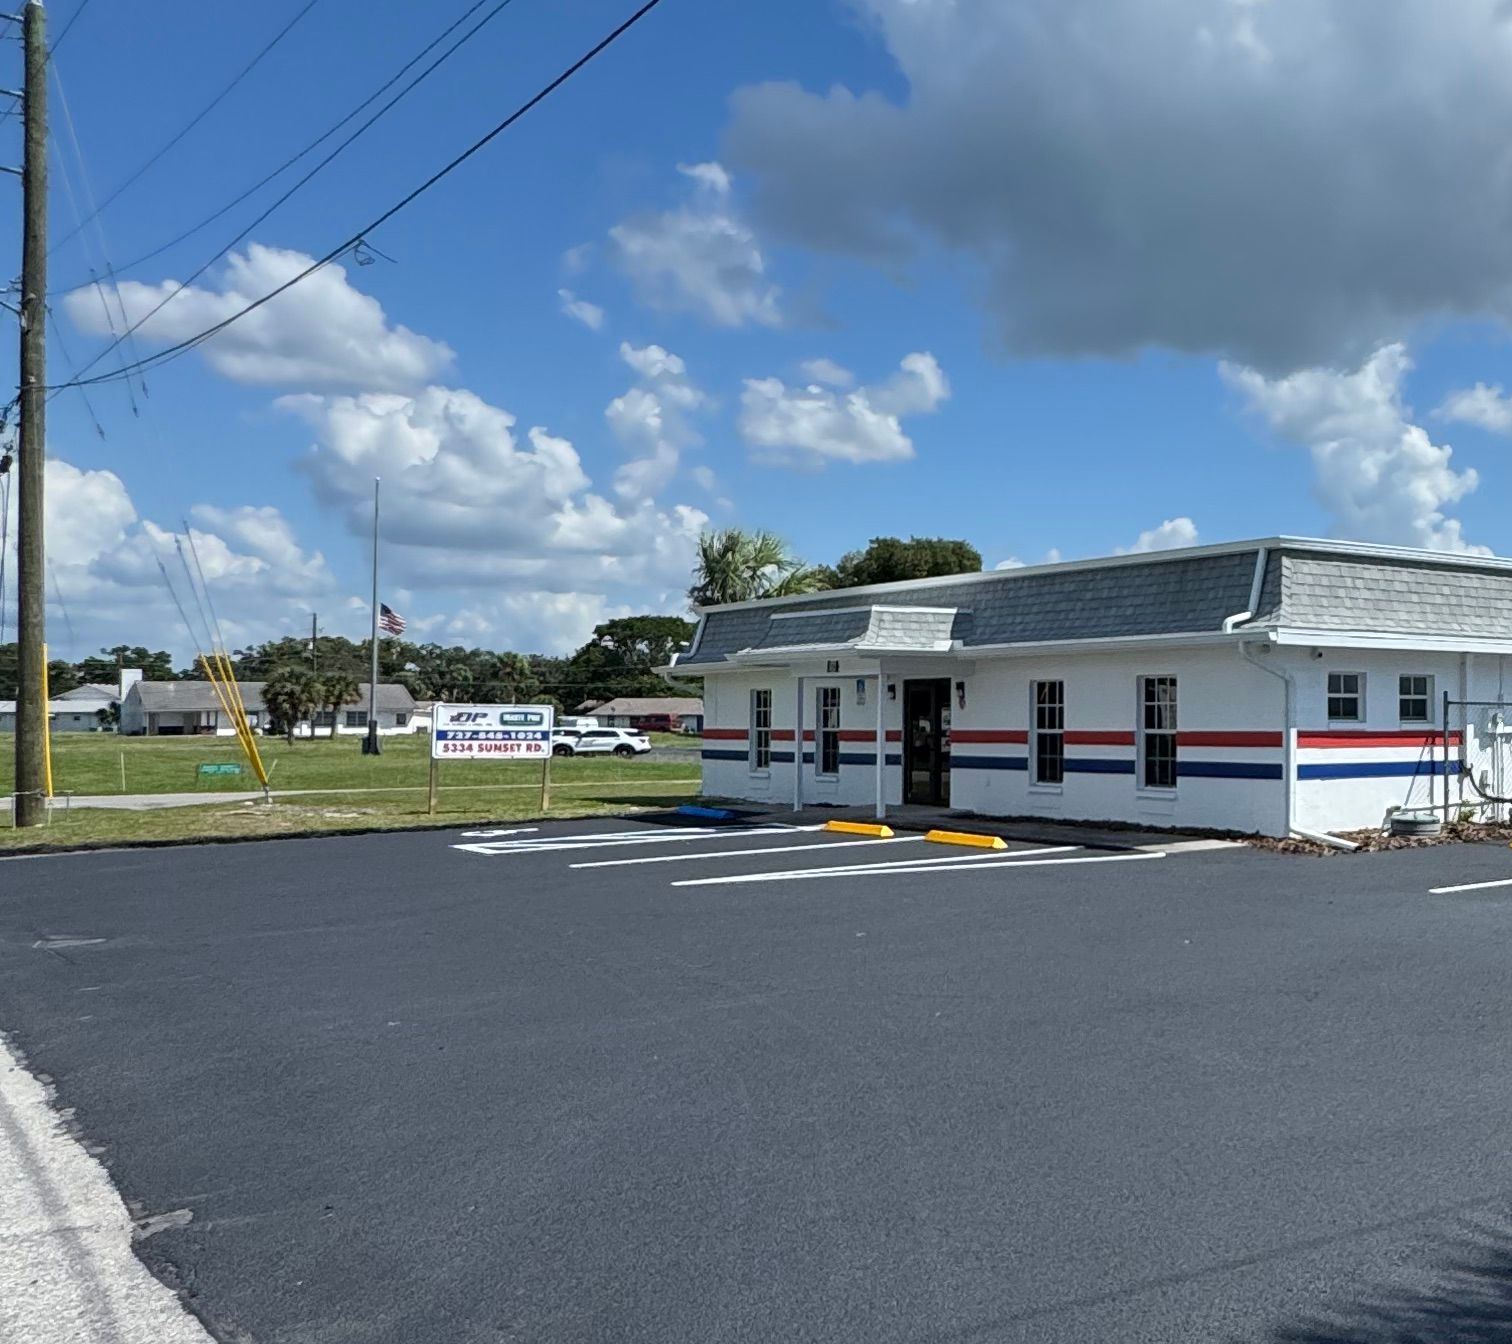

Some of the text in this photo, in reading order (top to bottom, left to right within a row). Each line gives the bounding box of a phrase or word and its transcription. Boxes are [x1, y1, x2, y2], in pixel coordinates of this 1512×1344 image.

[442, 743, 546, 753] 5334 SUNSET RD.
